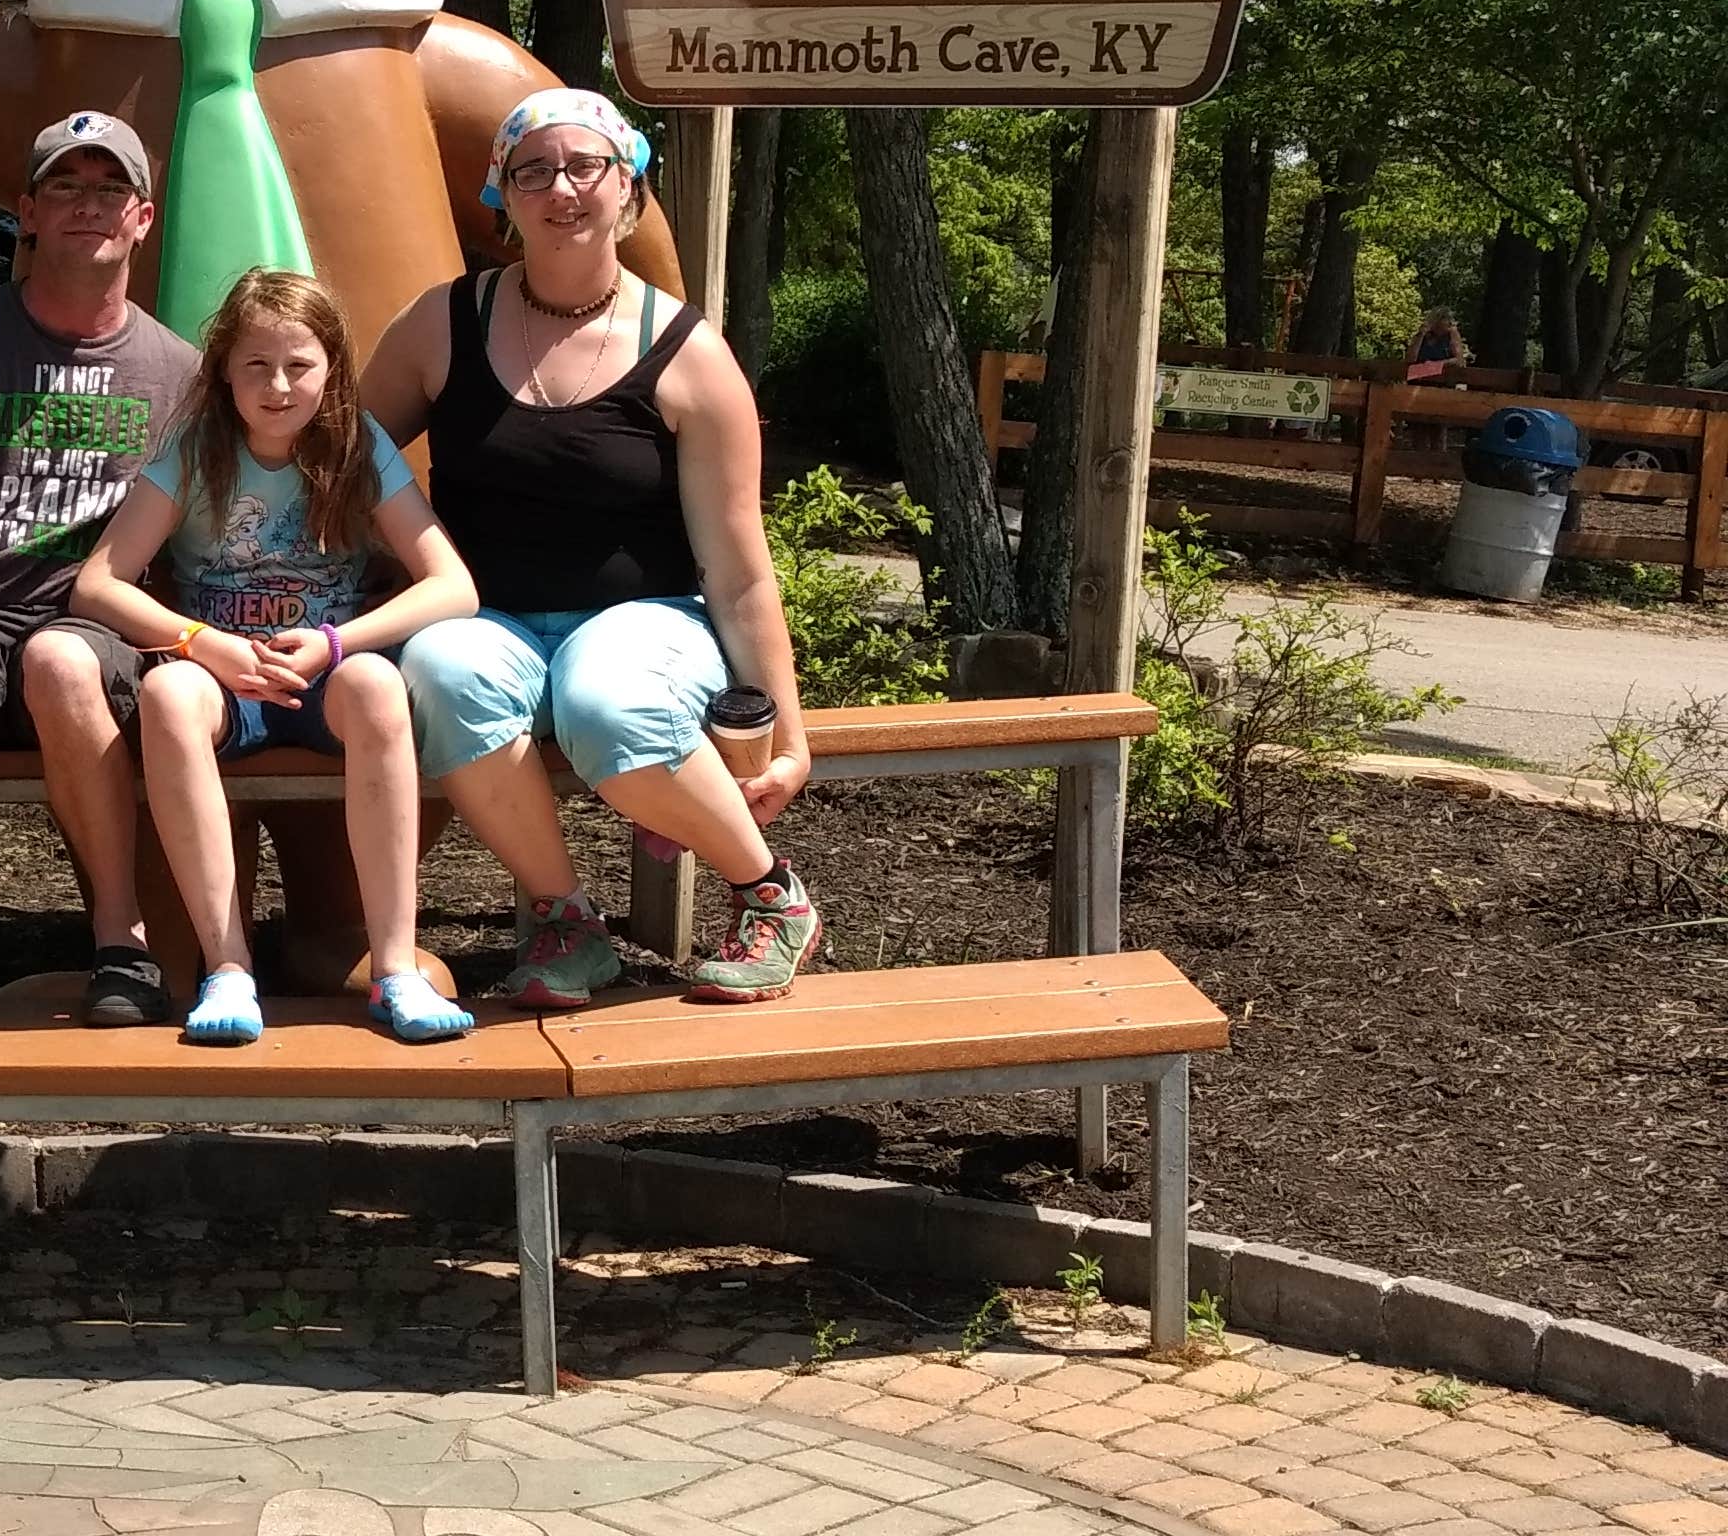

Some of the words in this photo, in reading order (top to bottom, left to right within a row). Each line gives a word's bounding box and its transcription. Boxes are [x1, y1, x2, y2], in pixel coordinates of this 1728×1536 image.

[665, 24, 920, 75] Mammoth
[937, 24, 1071, 78] Cave,
[1089, 20, 1173, 76] KY
[34, 363, 66, 393] I'M
[71, 365, 115, 395] NOT
[1197, 373, 1238, 393] Ranger
[1240, 377, 1271, 391] Smith
[1187, 390, 1239, 411] Recycling
[1241, 395, 1279, 409] Center
[19, 447, 52, 476] I'M
[54, 448, 109, 479] JUST
[199, 589, 307, 627] FRIEND
